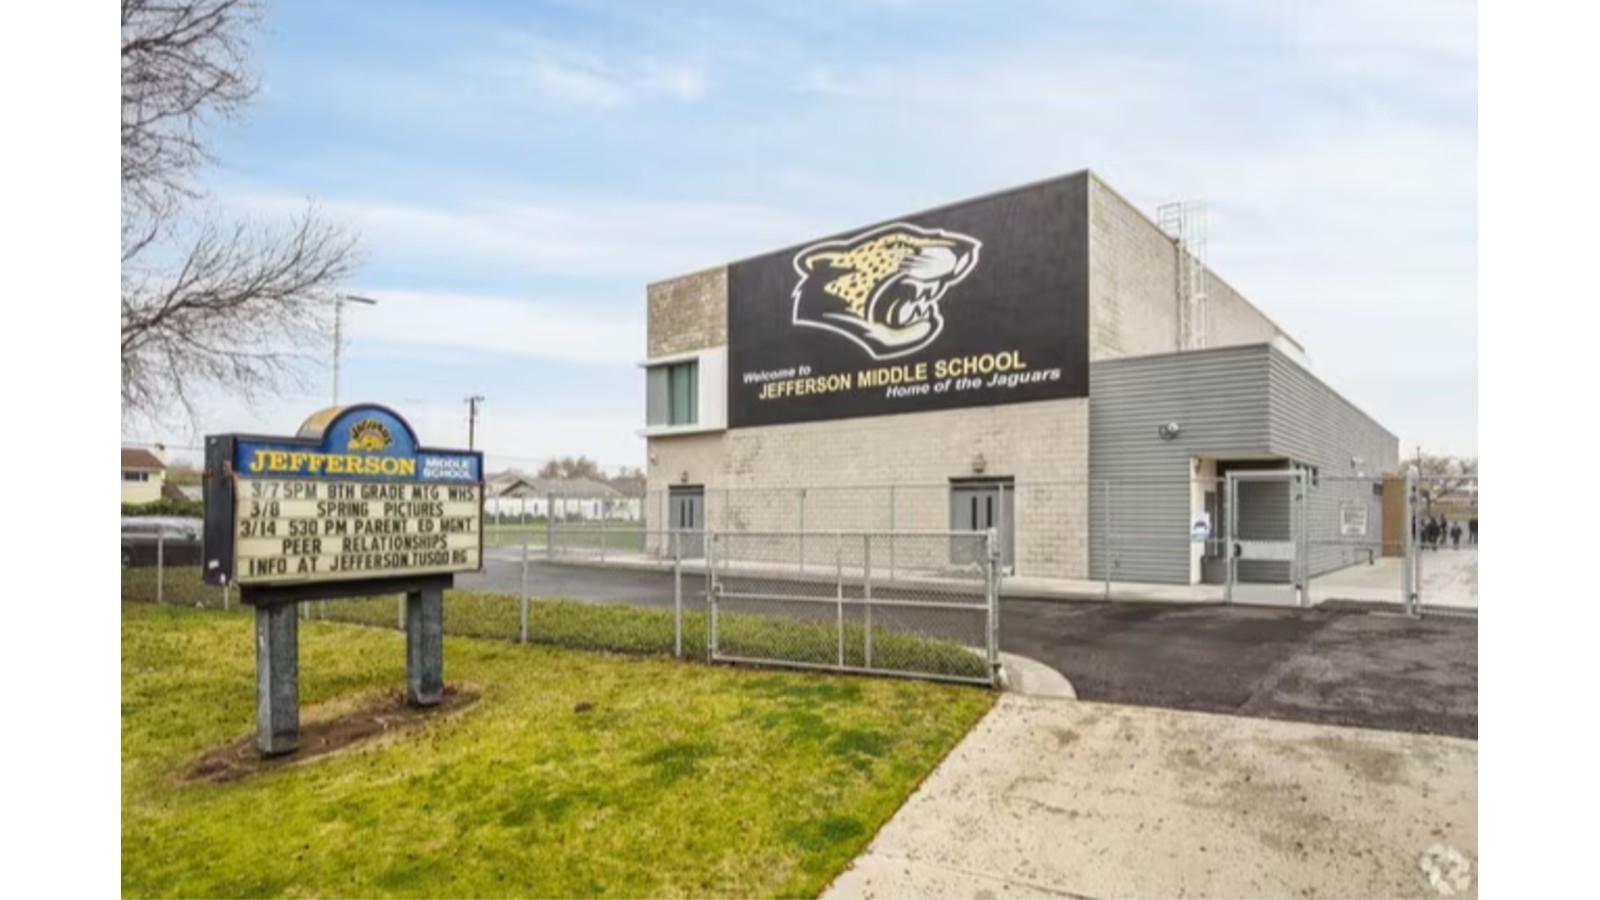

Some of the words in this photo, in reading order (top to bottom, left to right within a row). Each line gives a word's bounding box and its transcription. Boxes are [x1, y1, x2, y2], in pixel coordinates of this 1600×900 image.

[743, 366, 796, 384] Welcome
[799, 364, 812, 376] to
[759, 372, 852, 400] JEFFERSON
[857, 364, 927, 387] MIDDLE
[934, 349, 1027, 379] SCHOOL
[886, 384, 930, 399] Home
[933, 378, 952, 393] of
[955, 374, 983, 391] the
[986, 367, 1062, 389] Jaguars
[250, 450, 415, 475] JEFFERSON
[425, 457, 471, 468] MIDDLE
[423, 467, 473, 480] SCHOOL
[251, 482, 280, 498] 3/7
[283, 482, 317, 499] 5PM
[327, 483, 355, 499] 8TH
[360, 483, 406, 500] GRADE
[412, 484, 440, 500] MTG
[448, 485, 475, 501] WHS
[250, 500, 280, 519] 3/8
[317, 501, 369, 518] SPRING
[383, 501, 444, 517] PICTURES
[240, 519, 277, 538] 3/14
[289, 519, 319, 536] 530
[325, 519, 347, 536] PM
[354, 519, 407, 534] PARENT
[418, 518, 434, 533] ED
[282, 538, 322, 555] PEER
[342, 534, 448, 554] RELATIONSHIPS
[249, 558, 287, 576] INFO
[297, 556, 318, 573] AT
